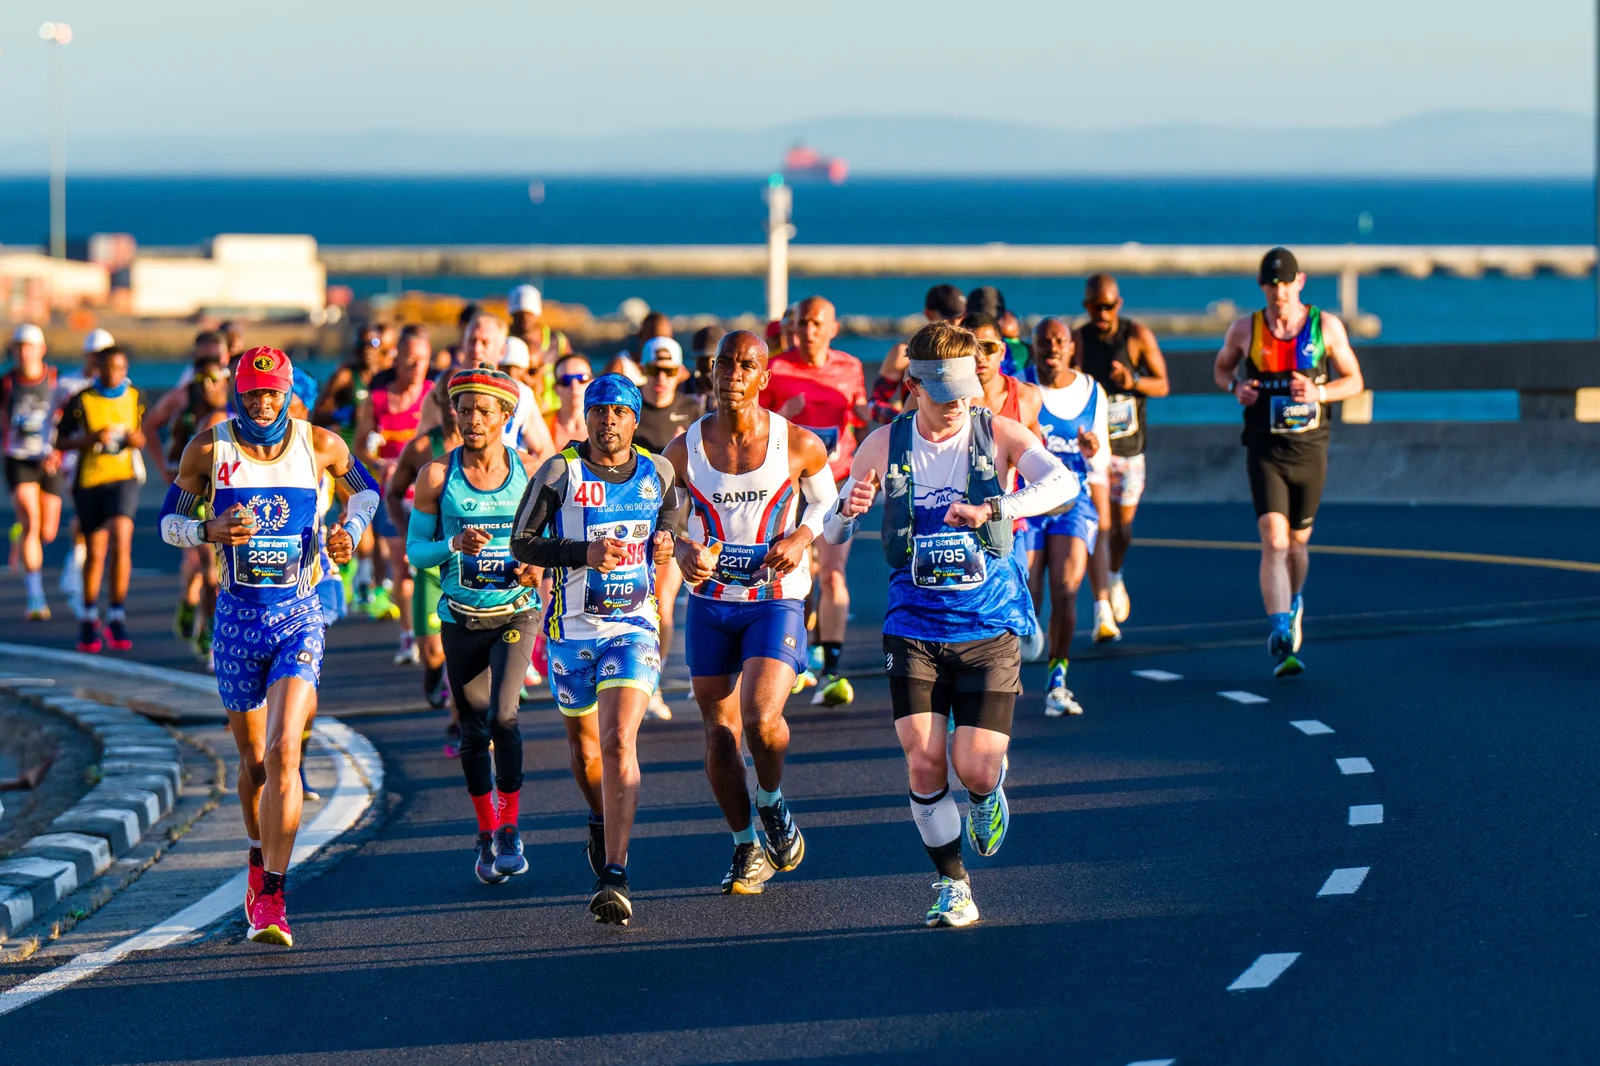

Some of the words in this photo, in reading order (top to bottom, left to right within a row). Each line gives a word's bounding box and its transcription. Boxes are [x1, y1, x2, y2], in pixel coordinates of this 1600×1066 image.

[574, 482, 604, 506] 40
[712, 490, 767, 503] SANDF
[257, 540, 288, 548] Sanlam
[936, 538, 967, 547] Sanlam
[725, 546, 754, 554] Sanlam
[928, 548, 966, 564] 1795
[248, 550, 288, 564] 2329
[720, 554, 752, 569] 2217
[476, 560, 505, 572] 1271
[610, 572, 637, 580] Sanlam
[604, 582, 634, 596] 1716
